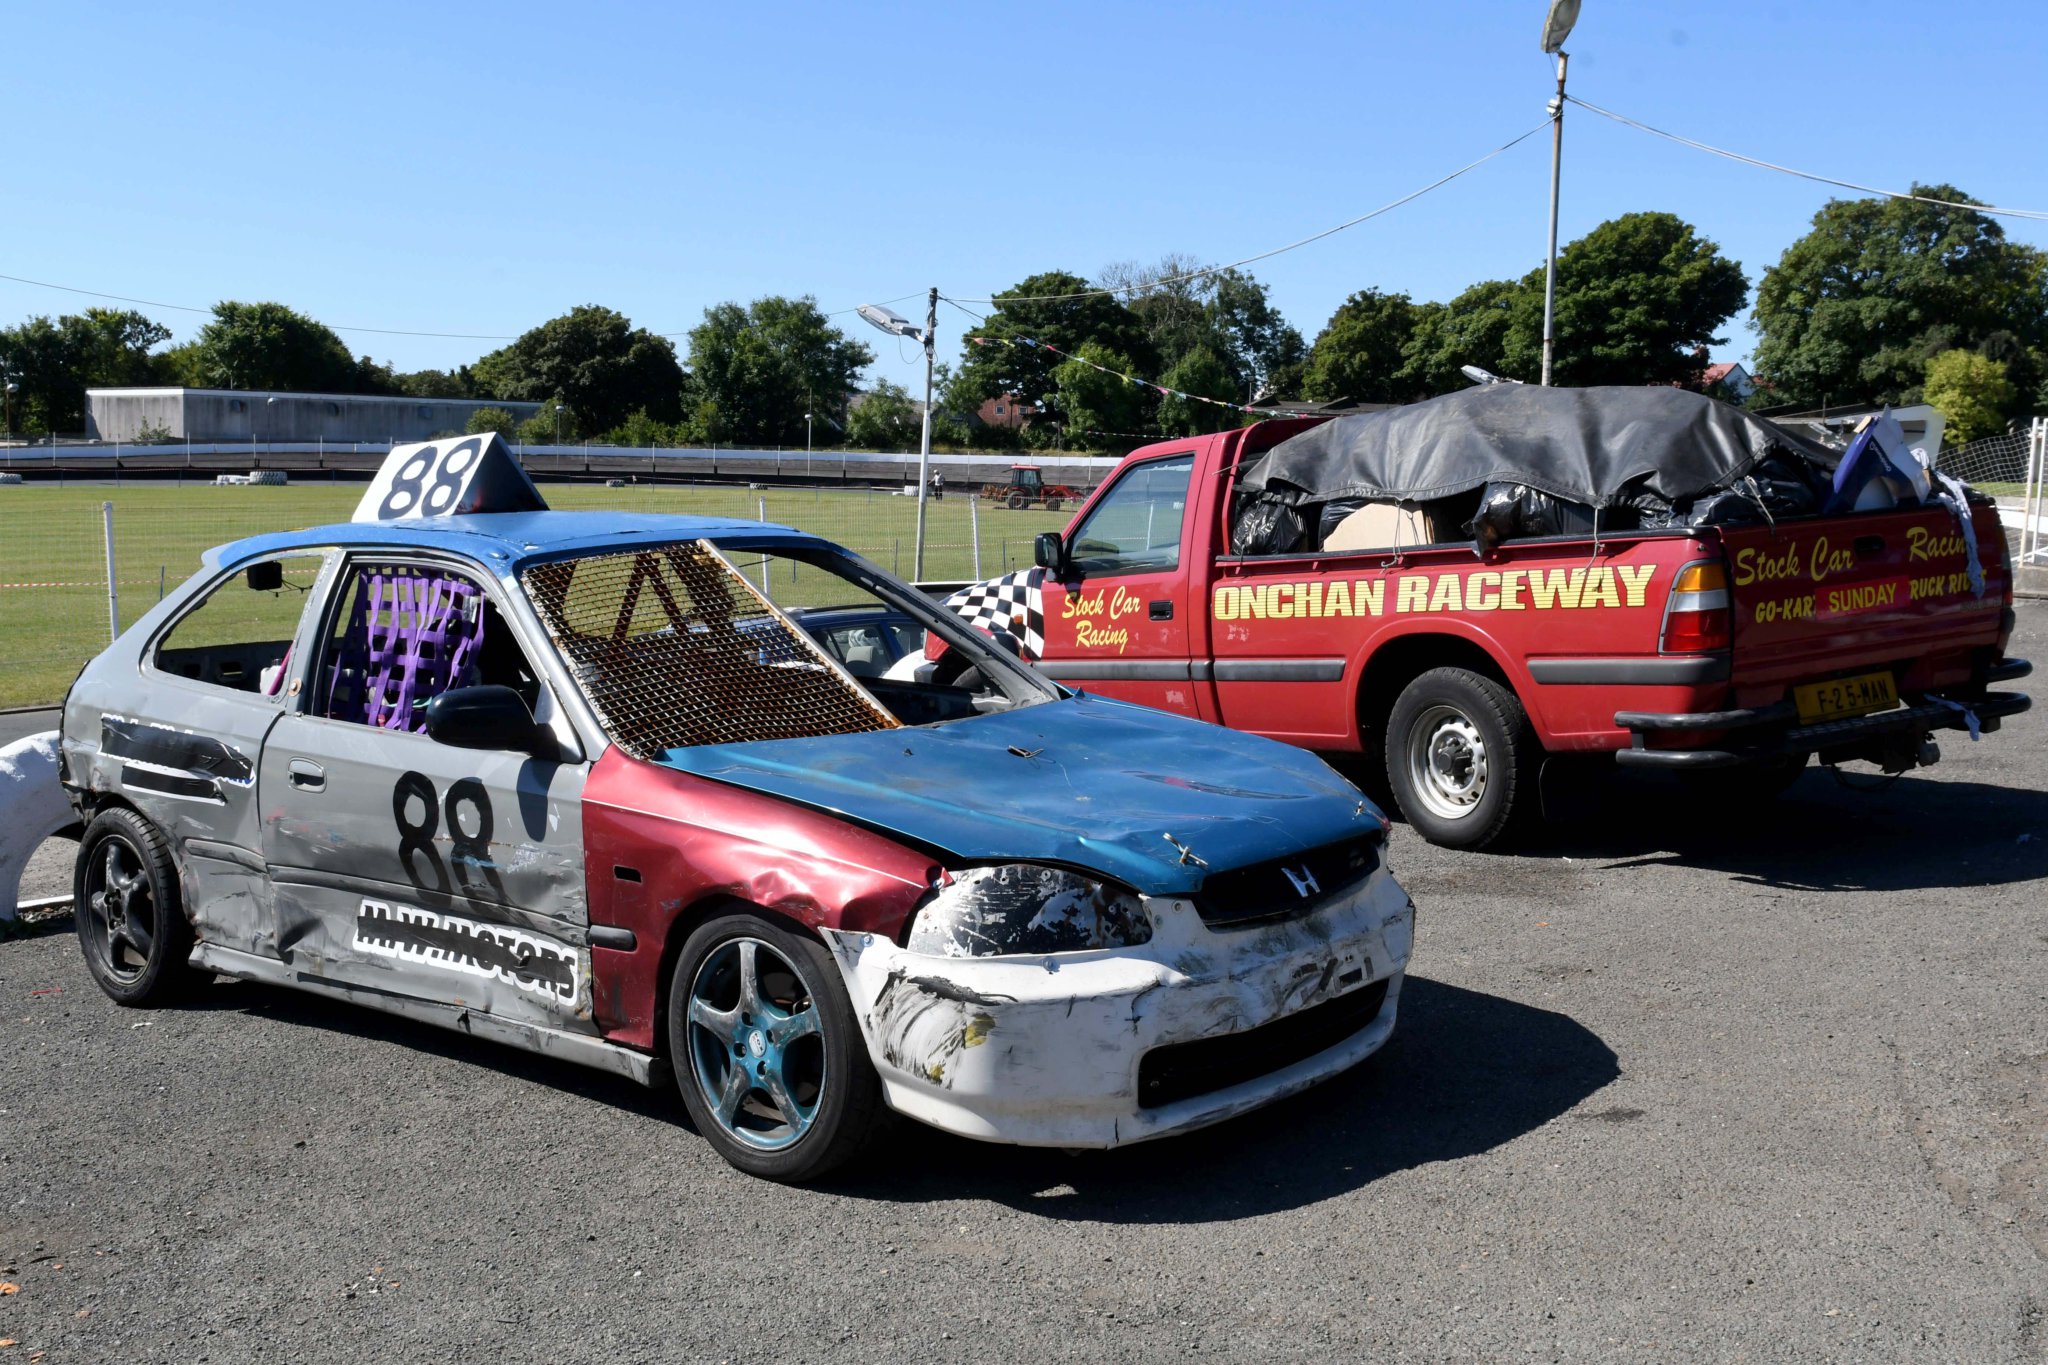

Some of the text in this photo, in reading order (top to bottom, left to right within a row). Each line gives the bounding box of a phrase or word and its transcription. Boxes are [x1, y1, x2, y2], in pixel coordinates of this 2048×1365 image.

[378, 437, 482, 520] 88
[1735, 526, 1966, 586] Stock Car Racin
[1062, 585, 1141, 620] Stock Car
[1214, 564, 1659, 620] ONCHAN RACEWAY
[1755, 595, 1816, 623] GO-KAR
[1828, 583, 1898, 613] SUNDAY
[1909, 574, 1945, 600] RUCK
[1075, 620, 1129, 654] Racing
[393, 770, 515, 912] 88
